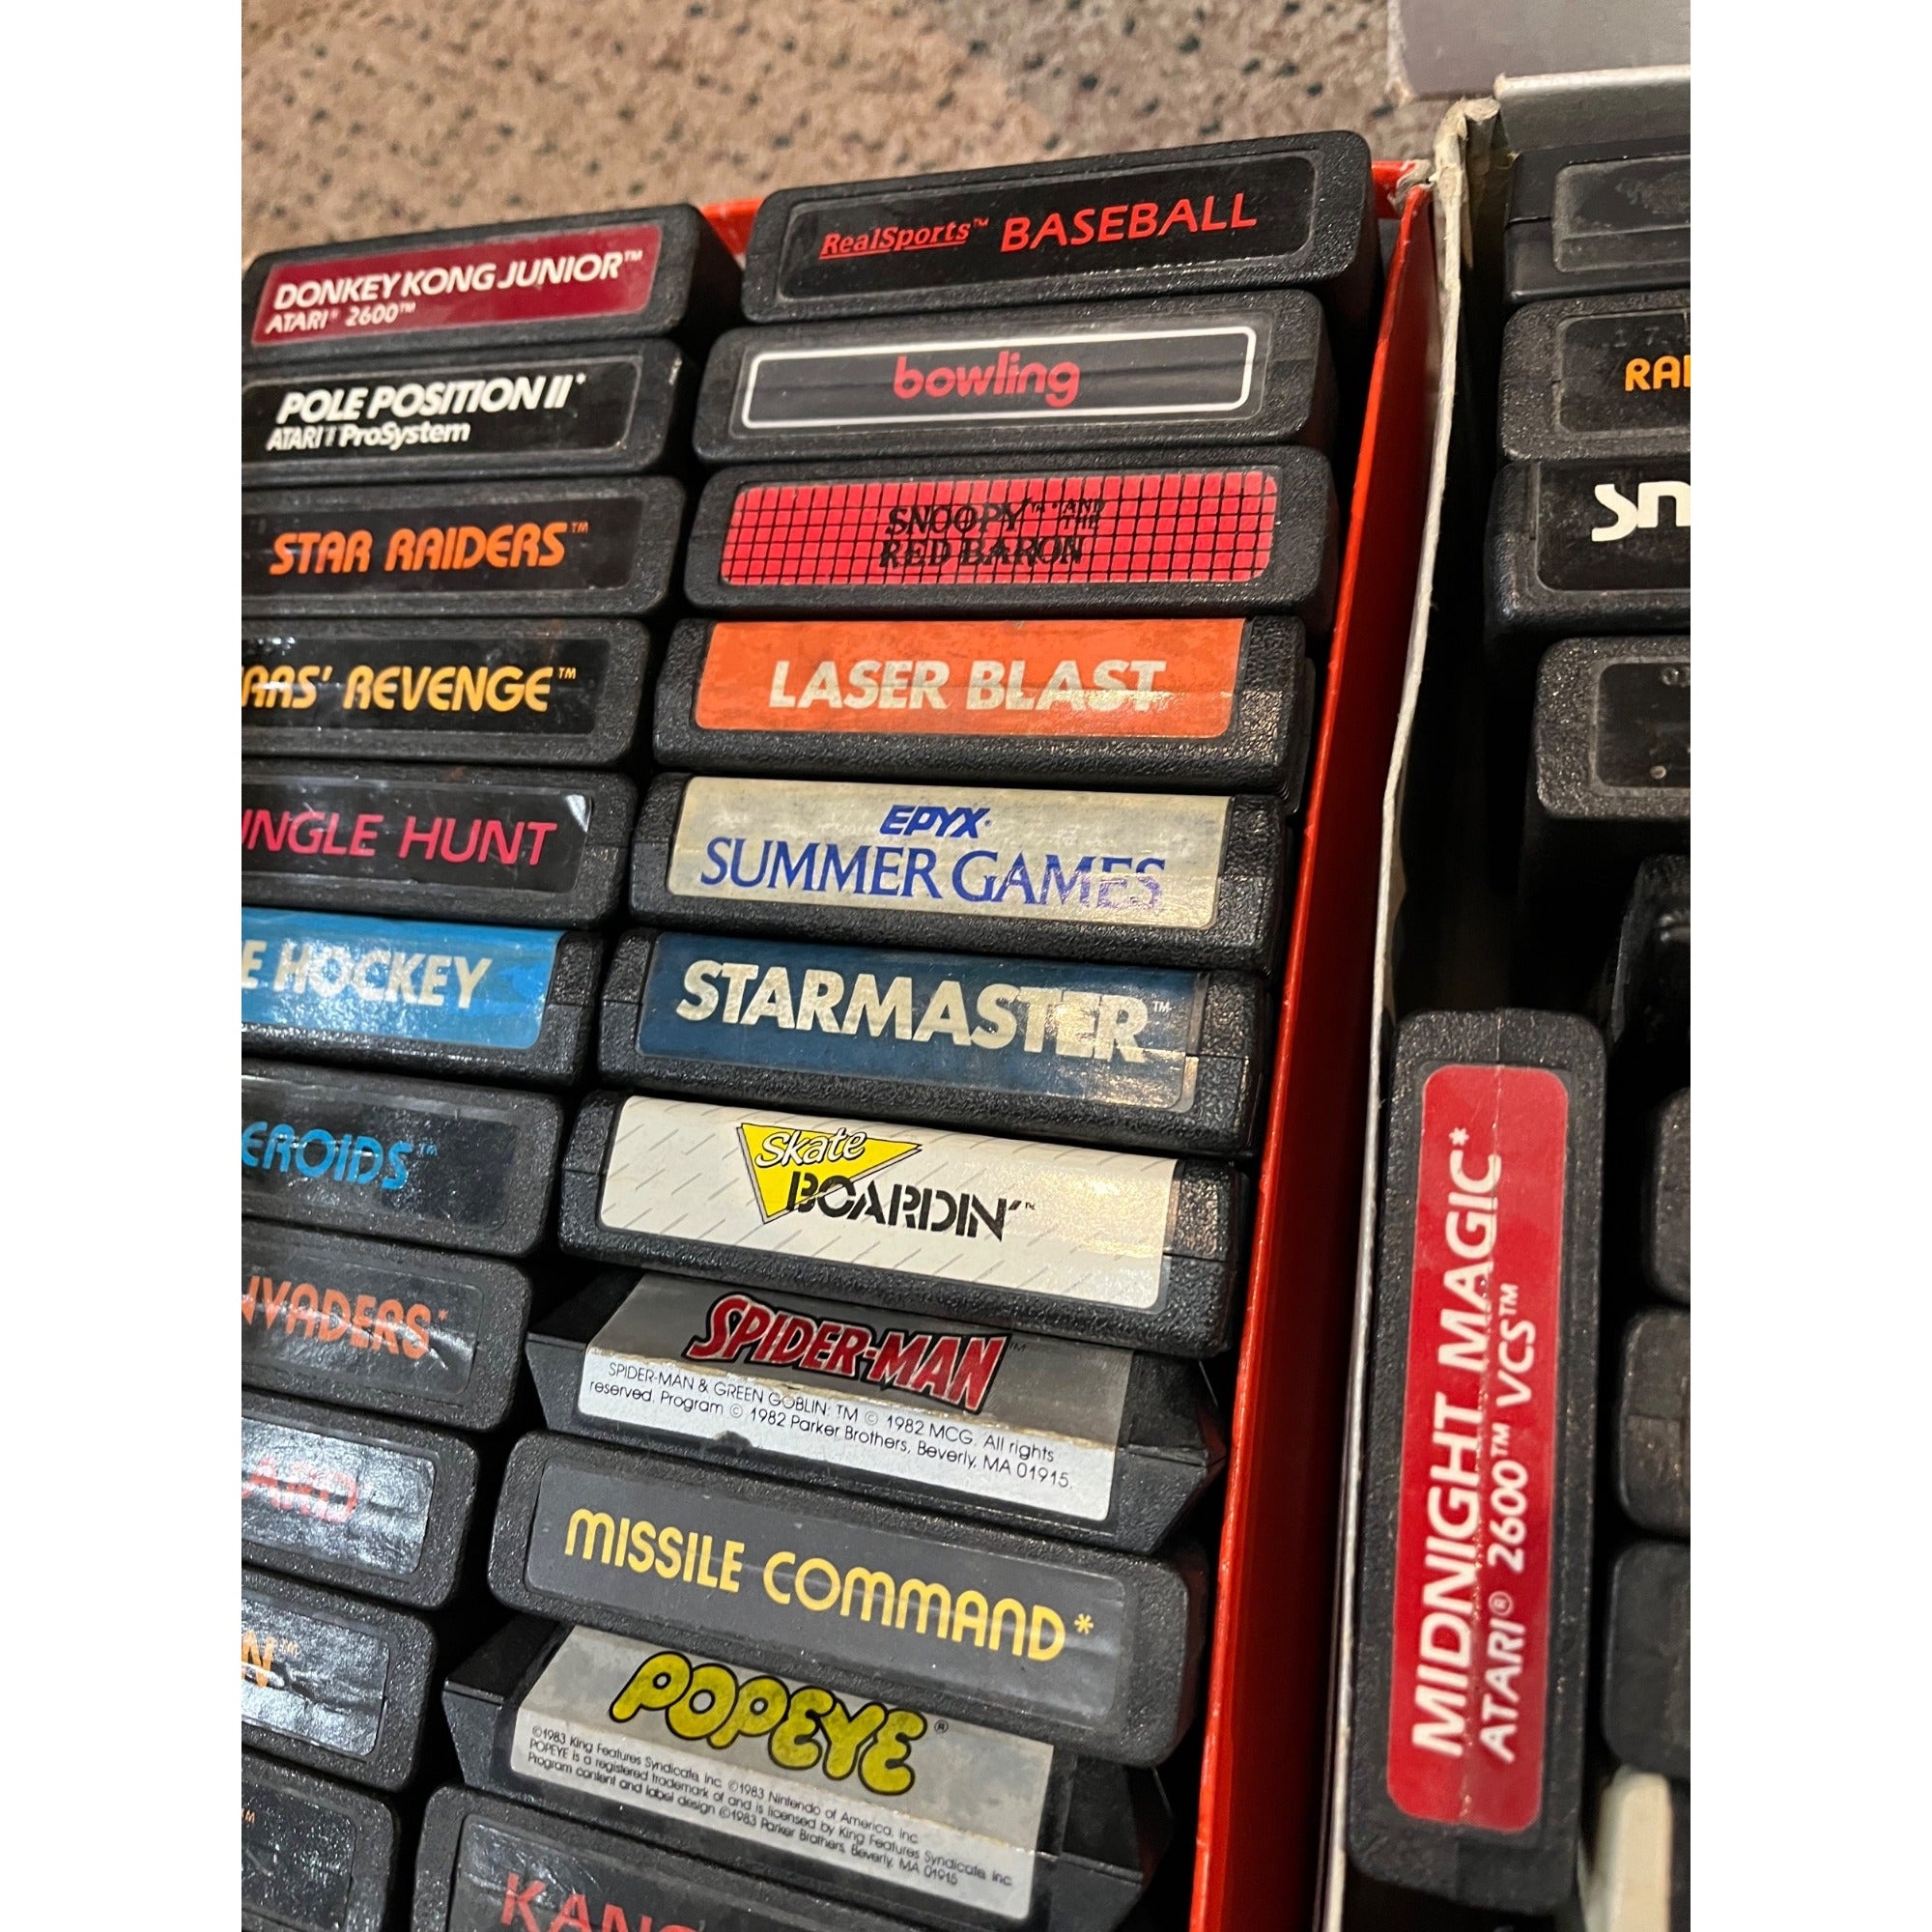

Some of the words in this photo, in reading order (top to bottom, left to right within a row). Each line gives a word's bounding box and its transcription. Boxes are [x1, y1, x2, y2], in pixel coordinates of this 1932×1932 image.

[1000, 192, 1257, 253] BASEBALL
[273, 272, 402, 311] DONKEY
[400, 263, 497, 298] KONG
[276, 387, 368, 425] POLE
[366, 376, 547, 419] POSITION
[893, 352, 1081, 408] bowling
[265, 425, 325, 451] ATARI
[338, 421, 471, 451] ProSystem
[1062, 497, 1106, 514] AND
[1062, 513, 1101, 530] THE
[269, 530, 373, 575] STAR
[879, 537, 952, 568] RED
[959, 534, 1086, 568] BARON
[242, 665, 333, 709] ARS'
[769, 659, 952, 709] LASER
[966, 659, 1167, 712] BLAST
[398, 816, 558, 866] HUNT
[880, 804, 992, 839] EPYX
[699, 837, 944, 899] SUMMER
[951, 850, 1167, 911] GAMES
[272, 939, 494, 1009] HOCKEY
[754, 1128, 867, 1169] Skate
[589, 1379, 656, 1404] reserved.
[661, 1390, 724, 1414] Program
[751, 1407, 786, 1428] 1982
[790, 1415, 840, 1437] Parker
[844, 1423, 911, 1454] Brothers,
[917, 1443, 977, 1469] Beverly,
[982, 1456, 1011, 1476] MA
[1016, 1463, 1074, 1490] 01915.
[609, 1361, 695, 1391] SPIDER-MAN
[697, 1378, 710, 1394] &
[714, 1381, 764, 1405] GREEN
[837, 1404, 859, 1423] TM
[887, 1414, 925, 1436] 1982
[929, 1422, 977, 1447] MCG.
[983, 1435, 1005, 1451] All
[1009, 1440, 1055, 1463] rights
[564, 1508, 746, 1593] MISSILE
[1411, 1391, 1485, 1758] MIDNIGHT
[529, 1738, 569, 1759] POPEYE
[572, 1750, 580, 1762] is
[583, 1755, 591, 1766] a
[595, 1758, 648, 1781] registered
[651, 1773, 709, 1799] trademark
[713, 1791, 724, 1803] of
[728, 1795, 752, 1811] and
[755, 1801, 763, 1814] is
[768, 1805, 816, 1830] licensed
[820, 1819, 835, 1835] by
[838, 1825, 866, 1846] King
[869, 1835, 921, 1860] Features
[532, 1725, 566, 1745] ©1983
[569, 1736, 594, 1754] King
[597, 1743, 642, 1766] Features
[728, 1779, 765, 1800] ©1983
[768, 1790, 821, 1816] Nintendo
[825, 1806, 837, 1820] of
[527, 1750, 573, 1774] Program
[576, 1767, 616, 1786] content
[619, 1779, 642, 1794] and
[645, 1784, 674, 1803] label
[677, 1795, 716, 1816] design
[719, 1805, 757, 1827] ©1983
[760, 1816, 796, 1838] Parker
[898, 1857, 920, 1874] MA
